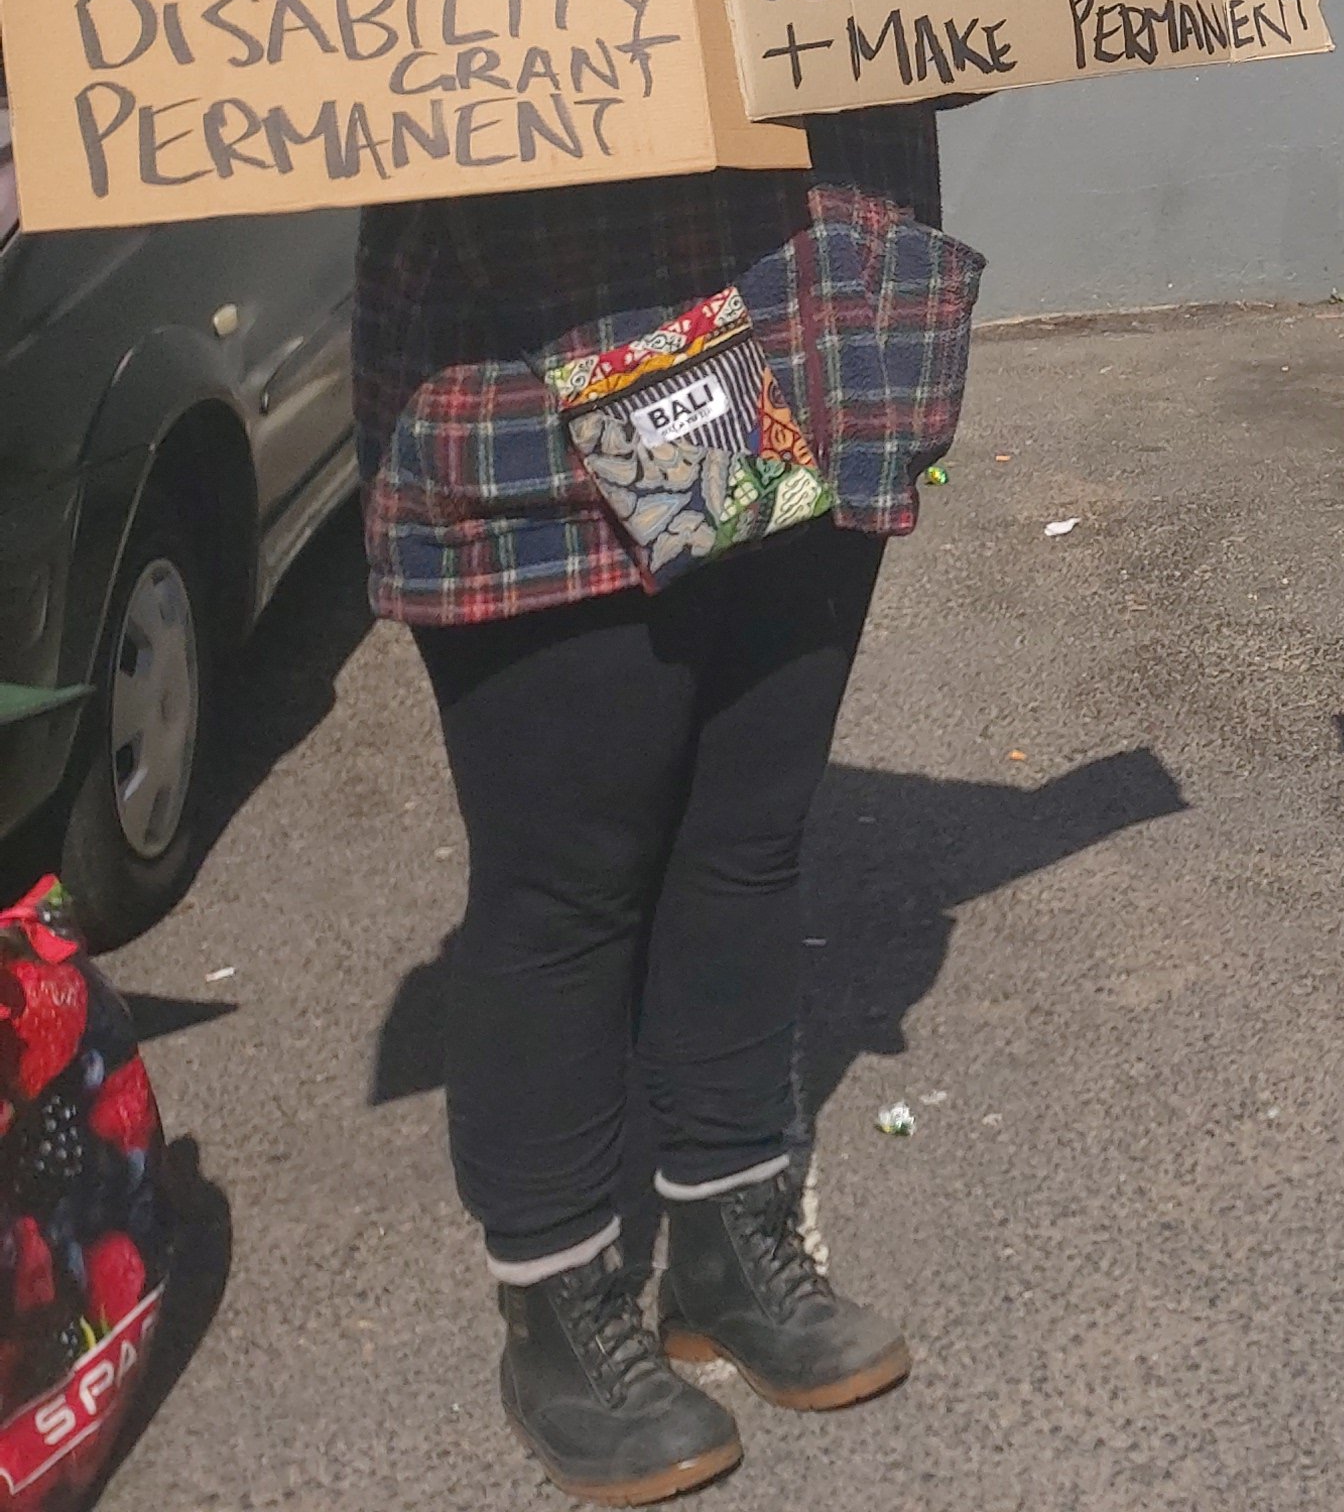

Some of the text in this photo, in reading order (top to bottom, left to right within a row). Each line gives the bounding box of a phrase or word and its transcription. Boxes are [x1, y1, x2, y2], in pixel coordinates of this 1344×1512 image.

[388, 34, 681, 98] GRANT
[74, 80, 625, 199] PERMANENT
[649, 384, 714, 430] BALI
